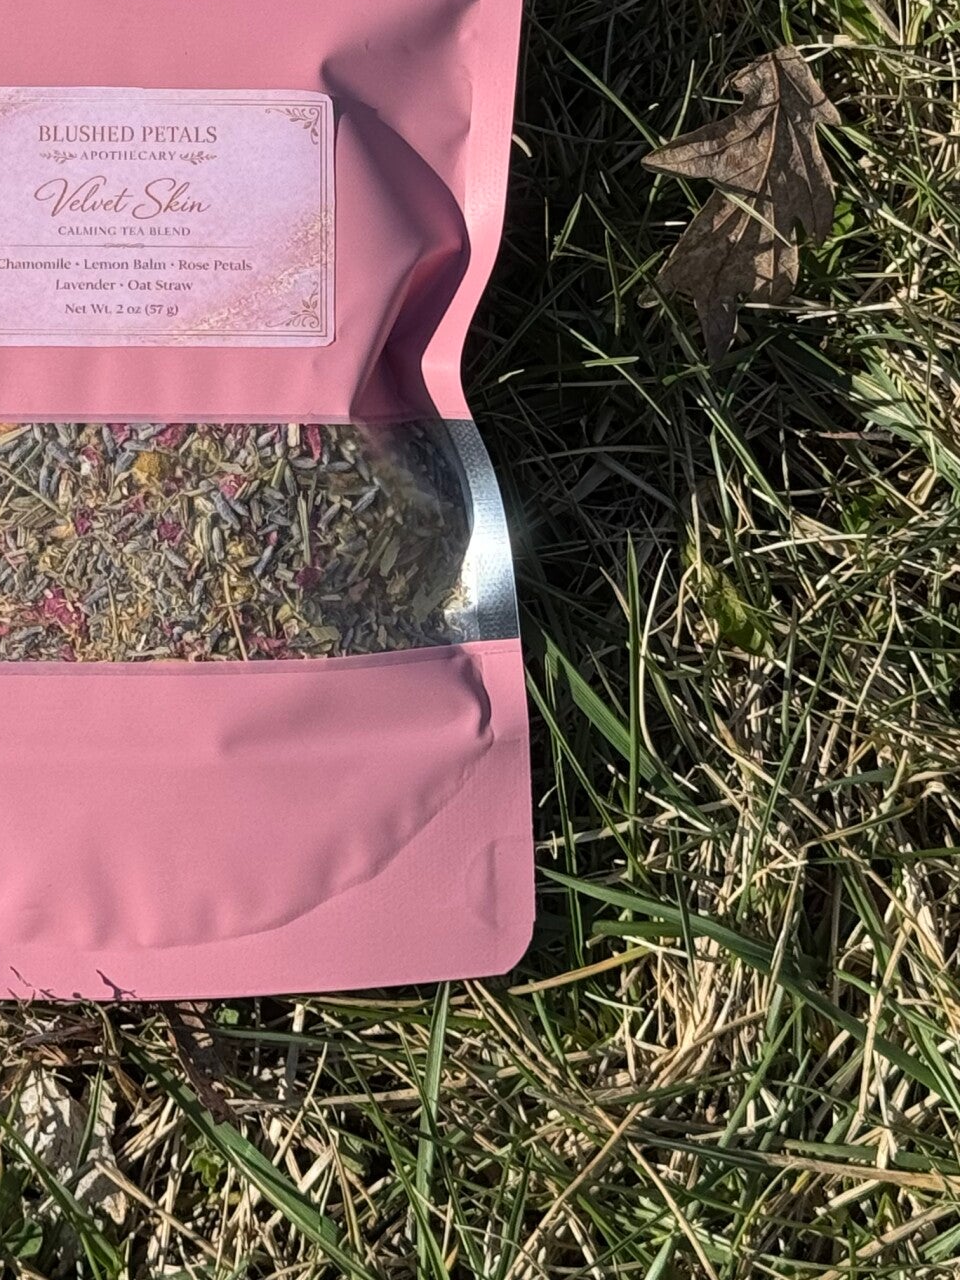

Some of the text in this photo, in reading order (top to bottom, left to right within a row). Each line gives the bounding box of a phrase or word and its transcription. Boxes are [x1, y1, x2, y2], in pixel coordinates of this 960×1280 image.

[39, 125, 217, 143] BLUSHED PETALS
[80, 150, 176, 161] APOTHECARY
[34, 175, 211, 219] Velvet Skin
[58, 226, 191, 236] CALMING TEA BLEND
[84, 259, 129, 270] Lemon
[133, 259, 166, 270] Balm
[178, 260, 209, 271] Rose
[214, 260, 253, 271] Petals
[55, 279, 193, 291] Lavender Oat Straw
[65, 303, 179, 316] Net Wt. 2 oz (57 g)
